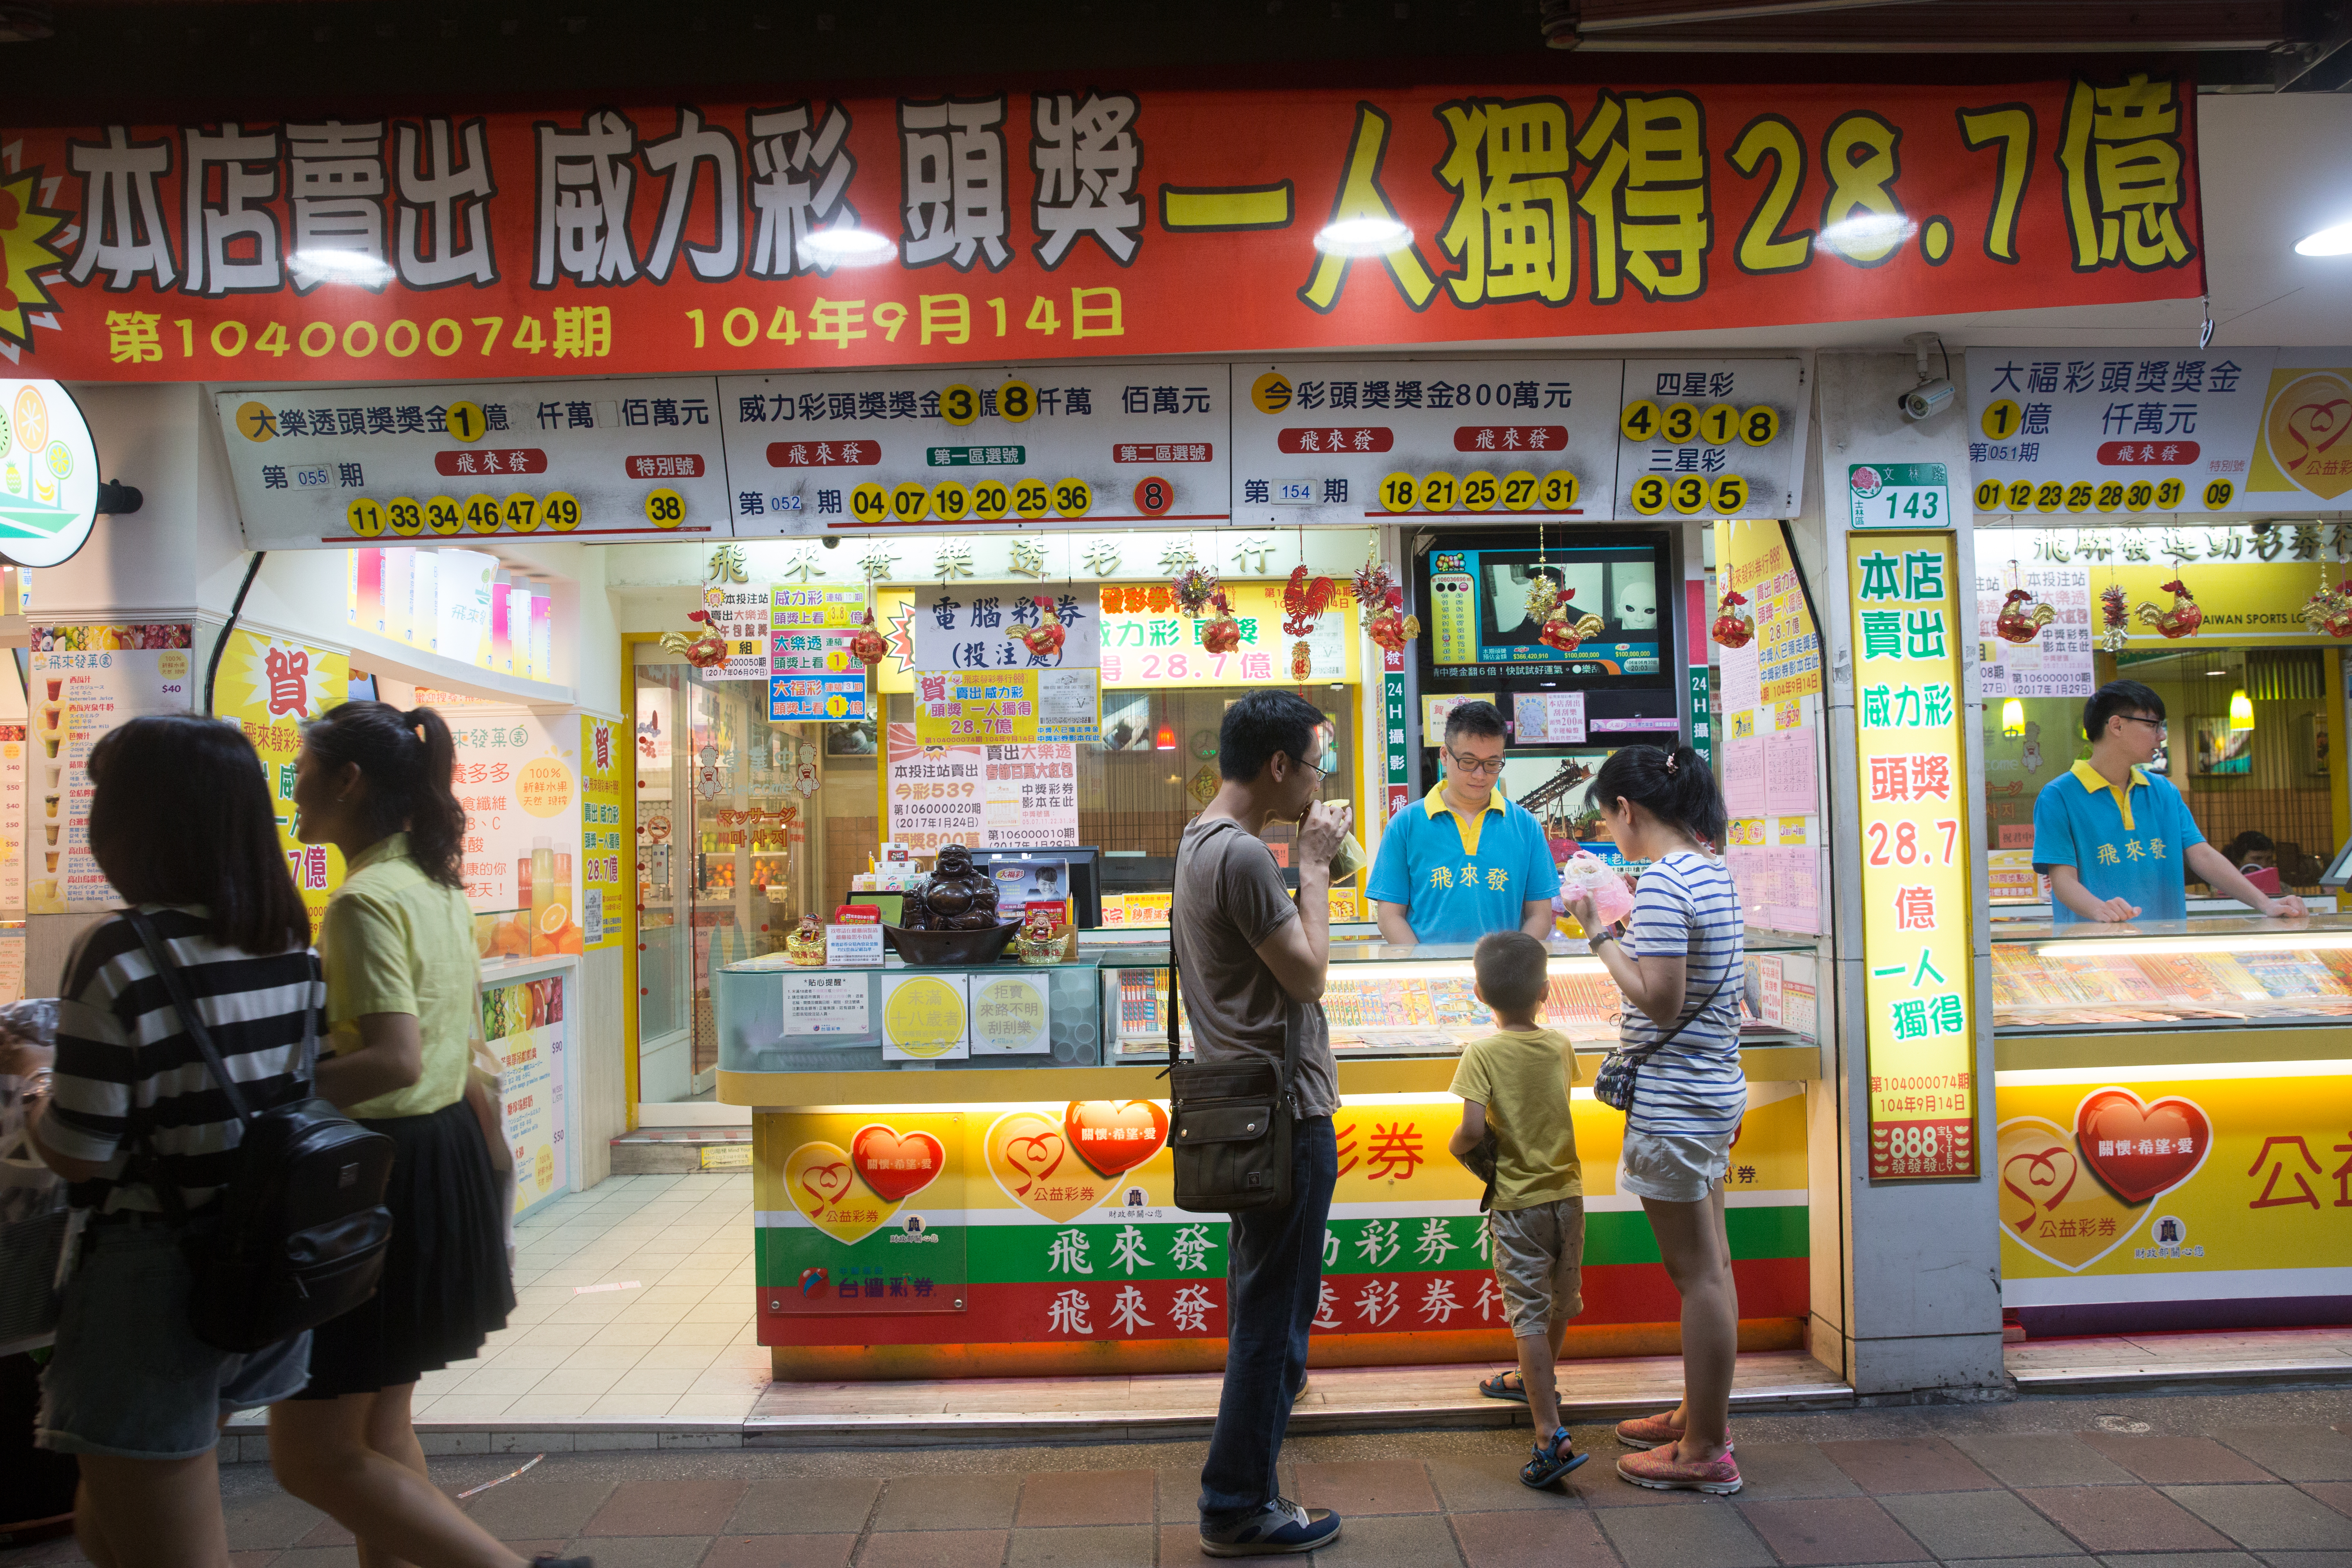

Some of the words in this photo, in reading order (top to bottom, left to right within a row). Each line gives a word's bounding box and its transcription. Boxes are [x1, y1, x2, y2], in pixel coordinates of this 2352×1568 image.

[60, 116, 499, 298] 本店賣出
[532, 100, 862, 290] 威力彩
[897, 91, 1143, 271] 頭獎
[105, 307, 611, 363] 第104000074期
[686, 287, 1124, 349] 104年9月14日
[1657, 372, 1735, 397] 四星彩
[1991, 360, 2242, 393] 大福彩頭獎獎金
[1122, 385, 1212, 414] 佰萬元
[622, 398, 709, 427] 佰萬元
[2103, 402, 2197, 434] 仟萬元
[1300, 429, 1374, 451] 飛來發
[1475, 428, 1550, 450] 飛來發
[788, 441, 862, 465] 飛來發
[934, 448, 1019, 465] 第一區選號
[1121, 445, 1205, 461] 第二區選號
[1648, 449, 1726, 472] 三星彩
[2117, 444, 2179, 461] 飛來發
[457, 450, 529, 473] 飛來發
[637, 457, 695, 477] 特別號
[2209, 459, 2245, 472] 特別號
[1882, 466, 1945, 481] 文林路
[854, 492, 884, 514] 04
[895, 492, 925, 514] 07
[936, 490, 963, 513] 19
[976, 488, 1006, 512] 20
[1017, 487, 1047, 510] 25
[1057, 486, 1087, 510] 36
[1145, 483, 1164, 510] 8
[1386, 481, 1412, 505] 18
[1426, 480, 1453, 504] 21
[1466, 479, 1495, 504] 25
[1506, 479, 1535, 503] 27
[1546, 479, 1573, 502] 31
[1978, 484, 1998, 504] 01
[2011, 486, 2030, 504] 12
[2038, 487, 2061, 506] 23
[2067, 487, 2091, 506] 25
[2098, 486, 2122, 506] 28
[2128, 486, 2152, 506] 30
[2158, 483, 2180, 503] 31
[2207, 484, 2230, 504] 09
[353, 507, 378, 530] 11
[390, 504, 420, 528] 33
[428, 504, 458, 527] 34
[467, 502, 499, 526] 46
[507, 501, 535, 525] 47
[546, 500, 577, 524] 49
[651, 497, 680, 521] 38
[1855, 500, 1864, 525] 士林區
[1886, 491, 1938, 519] 143
[1860, 551, 1944, 600] 本店
[2028, 572, 2085, 586] 本投注站
[726, 593, 768, 604] 本投注站
[774, 590, 822, 606] 威力彩
[933, 595, 1086, 630] 電腦彩券
[2202, 614, 2243, 625] AIWAN
[2246, 613, 2287, 625] SPORTS
[1862, 610, 1947, 660] 賣出
[2043, 629, 2089, 640] 中獎彩券
[774, 636, 822, 651] 大樂透
[2043, 641, 2090, 653] 影本在此
[49, 651, 112, 669] 飛來發菓園
[1295, 660, 1305, 675] 旺
[69, 676, 91, 684] 西瓜汁
[265, 647, 309, 718] 賀
[2012, 672, 2091, 684] 第106000010期
[162, 685, 181, 693] $40
[774, 680, 822, 697] 大福彩
[921, 675, 946, 702] 賀
[964, 675, 1012, 684] 飛來發彩券行
[985, 686, 1023, 699] 威力彩
[931, 703, 962, 717] 頭獎
[972, 702, 1031, 716] 一人獨得
[1861, 684, 1953, 728] 威力彩
[951, 718, 1013, 734] 28.7億
[595, 726, 609, 768] 賀
[987, 744, 1071, 761] 賣出大樂透
[722, 747, 794, 773] 營業中
[529, 768, 561, 778] 100%
[895, 764, 978, 778] 本投注站賣出
[986, 762, 1074, 780] 春節百萬大紅包
[1870, 755, 1949, 801] 頭獎
[523, 782, 568, 793] 新鮮水果
[725, 782, 793, 796] Welcome
[895, 783, 975, 800] 今彩539
[1022, 784, 1074, 795] 中獎彩券
[523, 796, 542, 806] 天然
[894, 803, 981, 815] 第106000020期
[1022, 796, 1074, 808] 影本在此
[720, 806, 797, 825] マッサージ
[896, 817, 979, 829] (2017年1月24日)
[988, 828, 1075, 840] 第106000010期
[1867, 820, 1957, 866] 28.7
[2098, 838, 2167, 866] 飛來發
[588, 855, 618, 883] 28.7億
[1430, 862, 1509, 892] 飛來發
[1874, 949, 1945, 987] 一人
[908, 989, 942, 1006] 未滿
[994, 985, 1023, 999] 拒賣
[980, 1002, 1038, 1017] 來路不明
[1892, 995, 1963, 1040] 獨得
[891, 1010, 959, 1027] 十八歲者
[988, 1020, 1031, 1035] 刮刮樂
[552, 1041, 563, 1054] $90
[1871, 1072, 1970, 1094] 第104000074期
[1880, 1094, 1965, 1114] 104年9月14日
[554, 1129, 564, 1144] $50
[1890, 1126, 1938, 1159] 888
[1892, 1158, 1938, 1174] 發發發
[1033, 1186, 1095, 1203] 公益彩券
[826, 1209, 879, 1223] 公益彩券
[1108, 1209, 1163, 1218] 財政部關心您
[2040, 1218, 2117, 1239] 公益彩券
[890, 1234, 938, 1244] 財政部關心您
[2134, 1245, 2205, 1259] 財政部關心您
[839, 1277, 935, 1298] 台灣彩券
